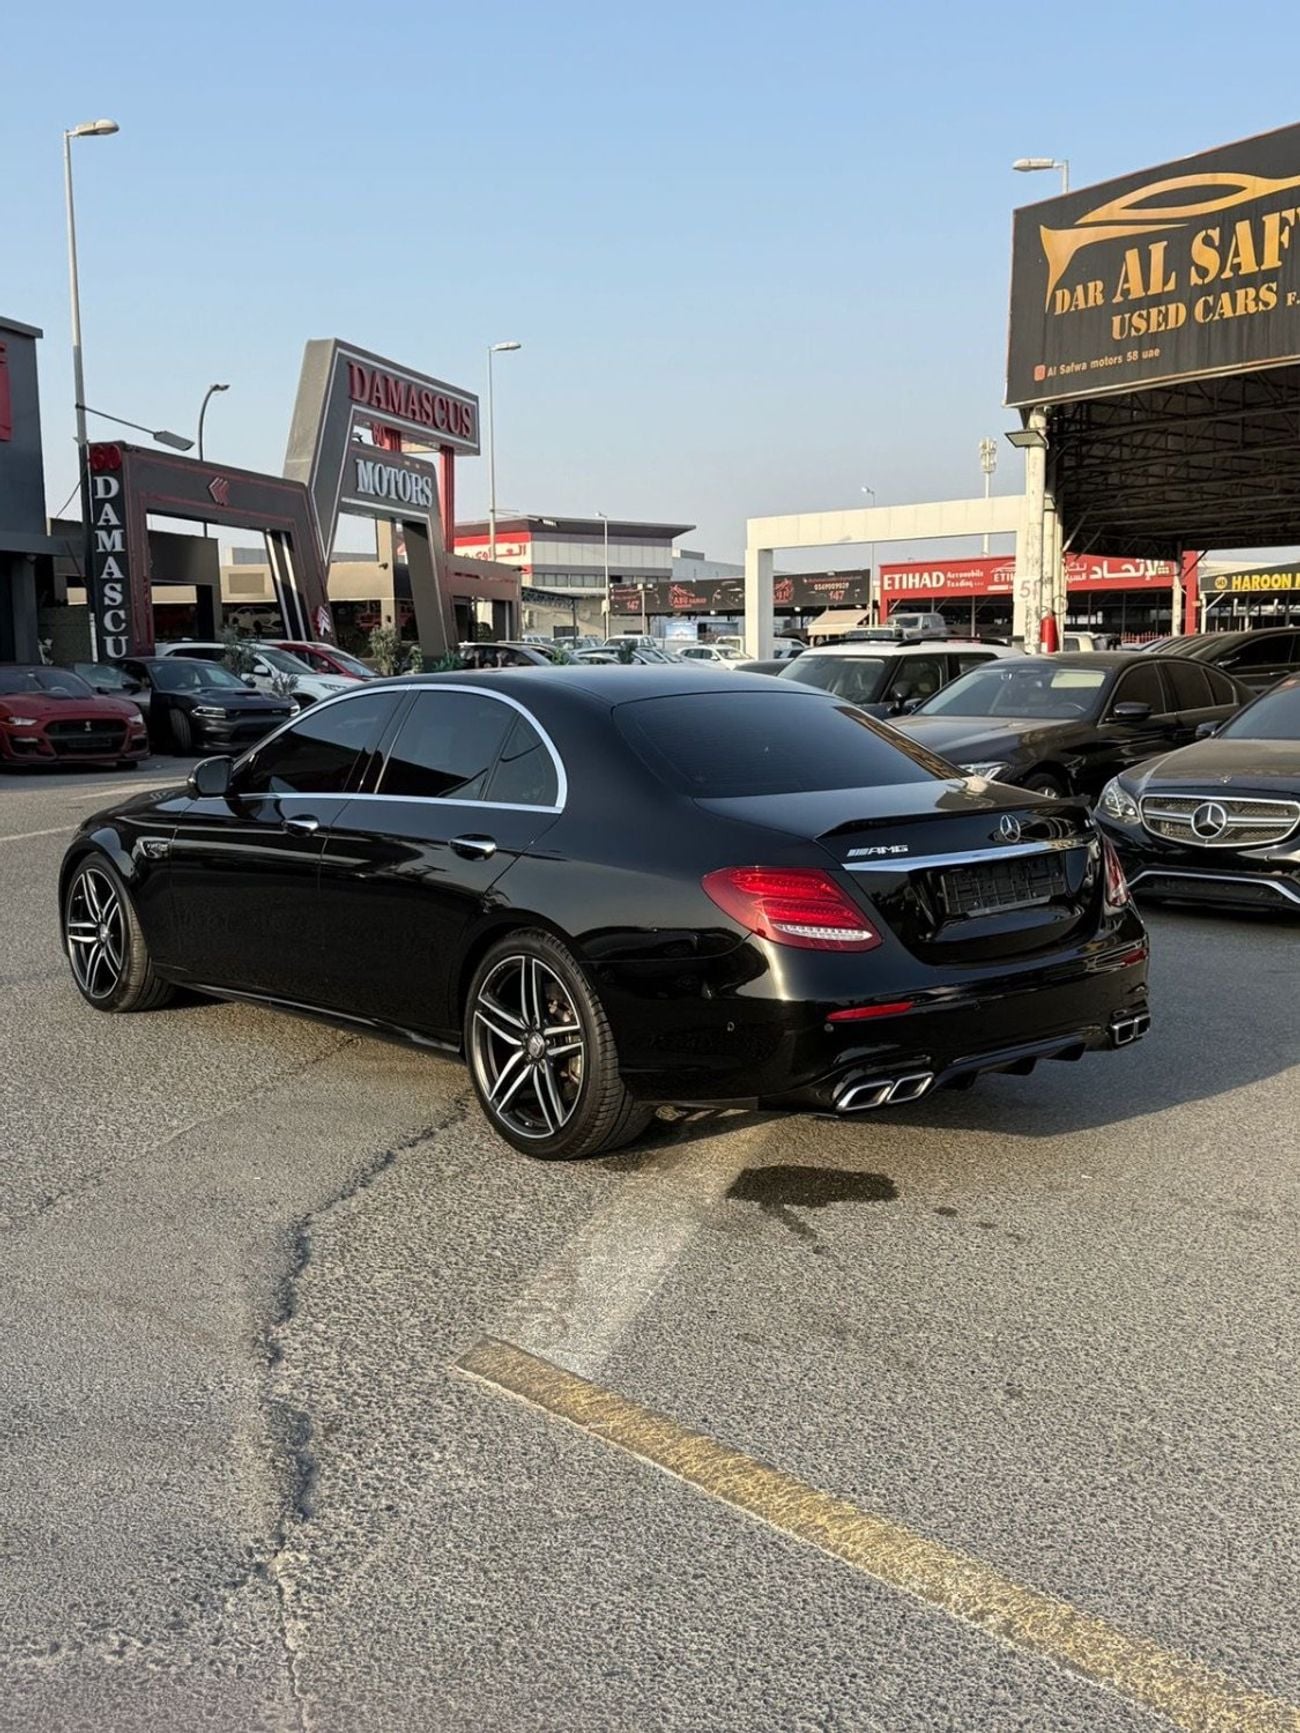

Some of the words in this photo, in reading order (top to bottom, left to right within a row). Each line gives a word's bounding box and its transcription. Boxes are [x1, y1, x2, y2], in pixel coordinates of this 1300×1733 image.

[1054, 280, 1104, 315] DAR
[1112, 240, 1176, 304] AL
[1190, 207, 1300, 287] SAF
[1112, 302, 1187, 340] USED
[1194, 282, 1277, 323] CARS
[1060, 362, 1087, 375] Safwa
[1090, 355, 1123, 369] motors
[1126, 350, 1139, 362] 58
[1142, 348, 1160, 359] uae
[349, 361, 473, 438] DAMASCUS
[355, 459, 432, 508] MOTORS
[883, 571, 945, 590] ETIHAD
[1232, 573, 1292, 590] HAROON
[867, 845, 908, 855] AMG
